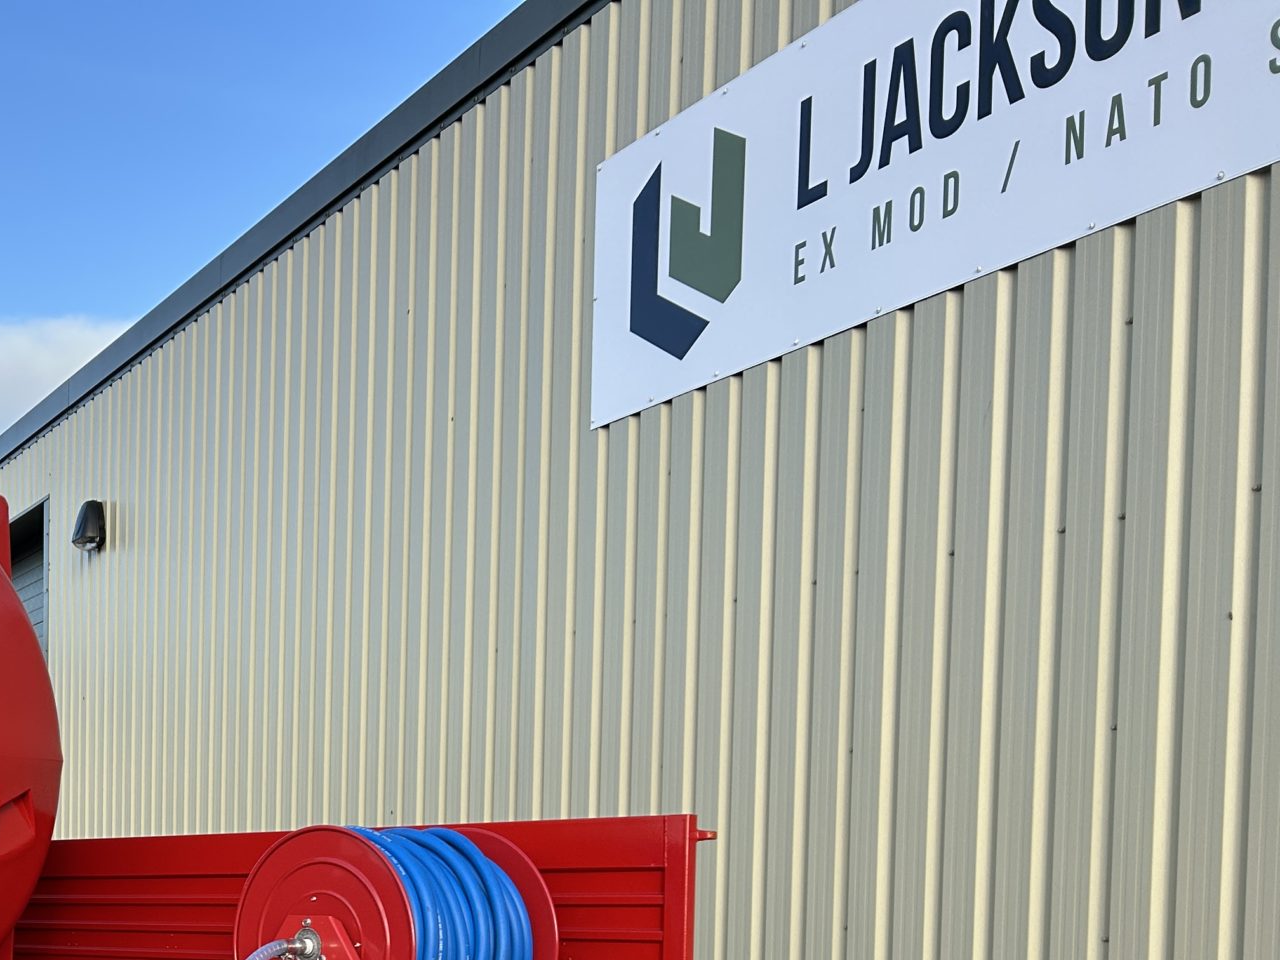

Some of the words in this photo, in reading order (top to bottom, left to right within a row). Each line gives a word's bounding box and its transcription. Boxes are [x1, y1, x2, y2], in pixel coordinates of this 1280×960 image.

[793, 226, 837, 286] EX
[870, 170, 960, 251] MOD
[1064, 53, 1212, 165] NATO
[797, 96, 828, 210] L
[849, 0, 1201, 185] JACKS
